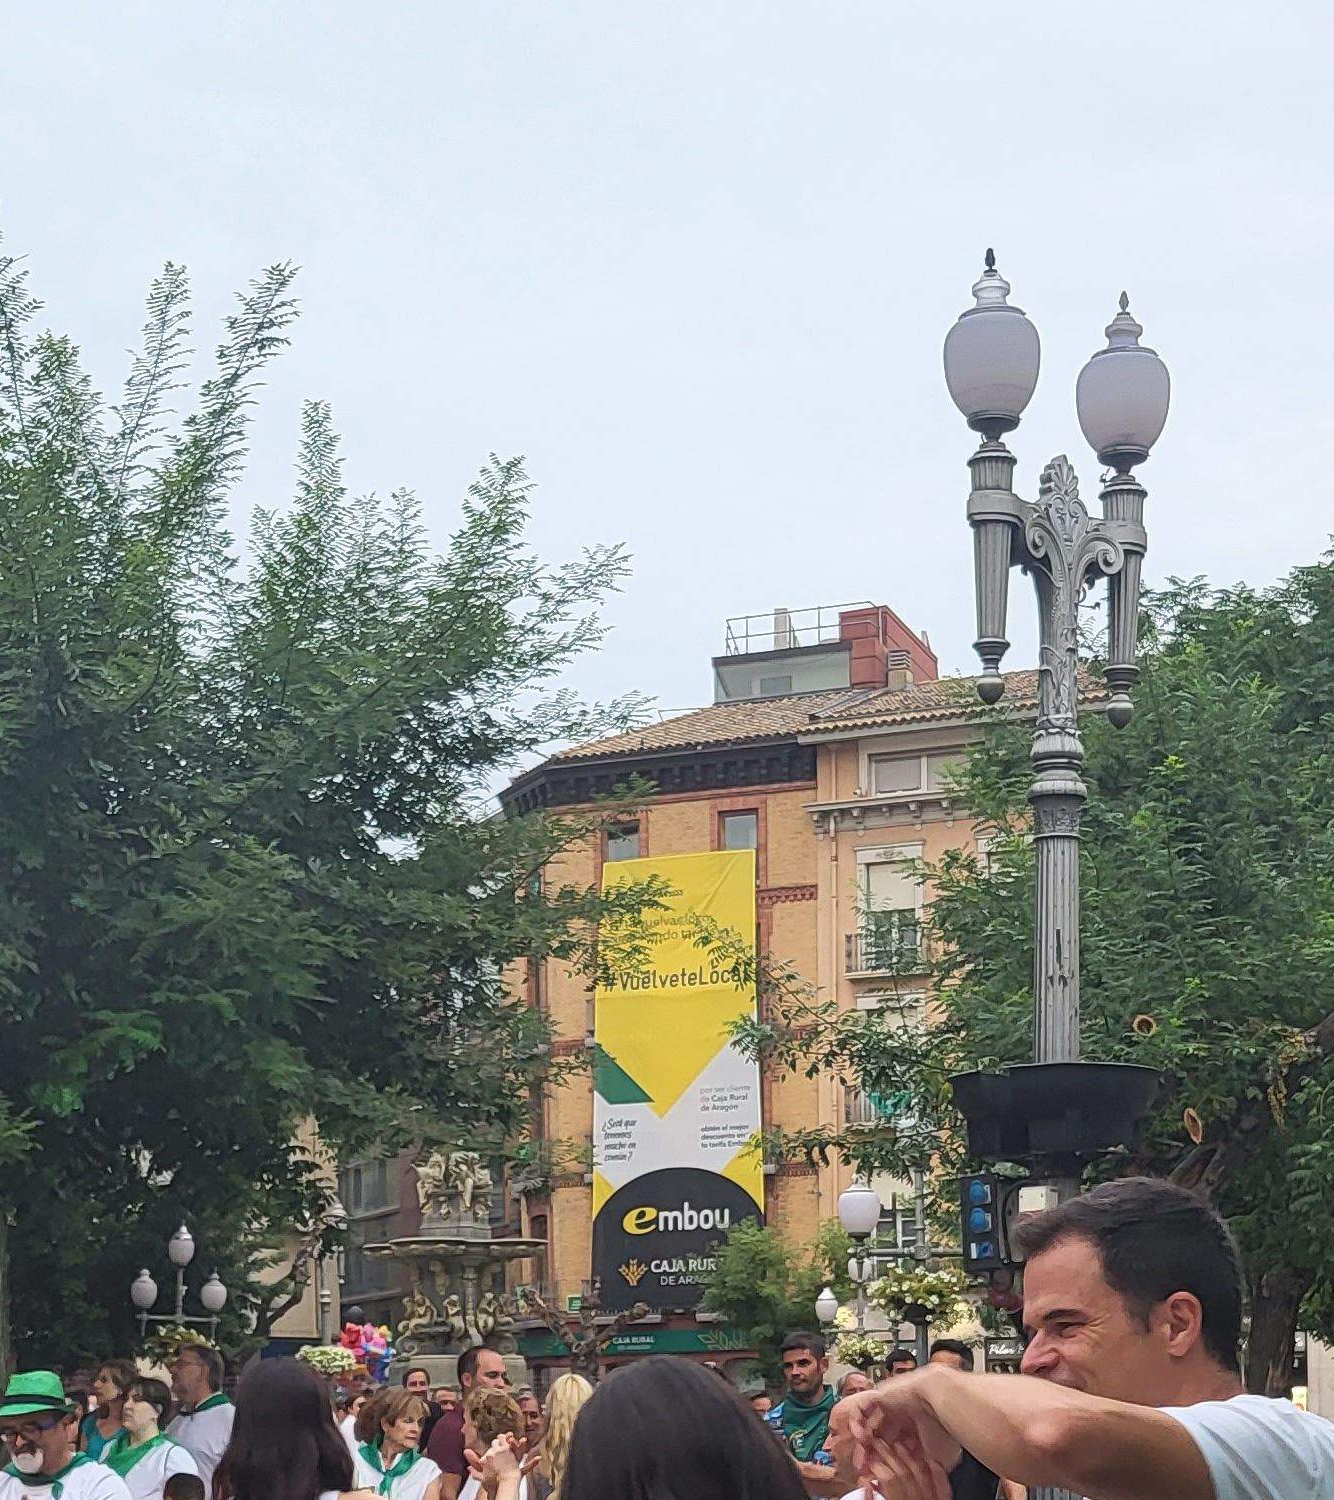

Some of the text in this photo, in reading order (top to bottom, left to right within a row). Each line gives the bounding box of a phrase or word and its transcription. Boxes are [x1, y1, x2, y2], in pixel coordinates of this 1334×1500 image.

[711, 1094, 727, 1103] Caja
[622, 1201, 730, 1235] embou
[650, 1257, 686, 1273] CAJA
[660, 1275, 676, 1286] DE
